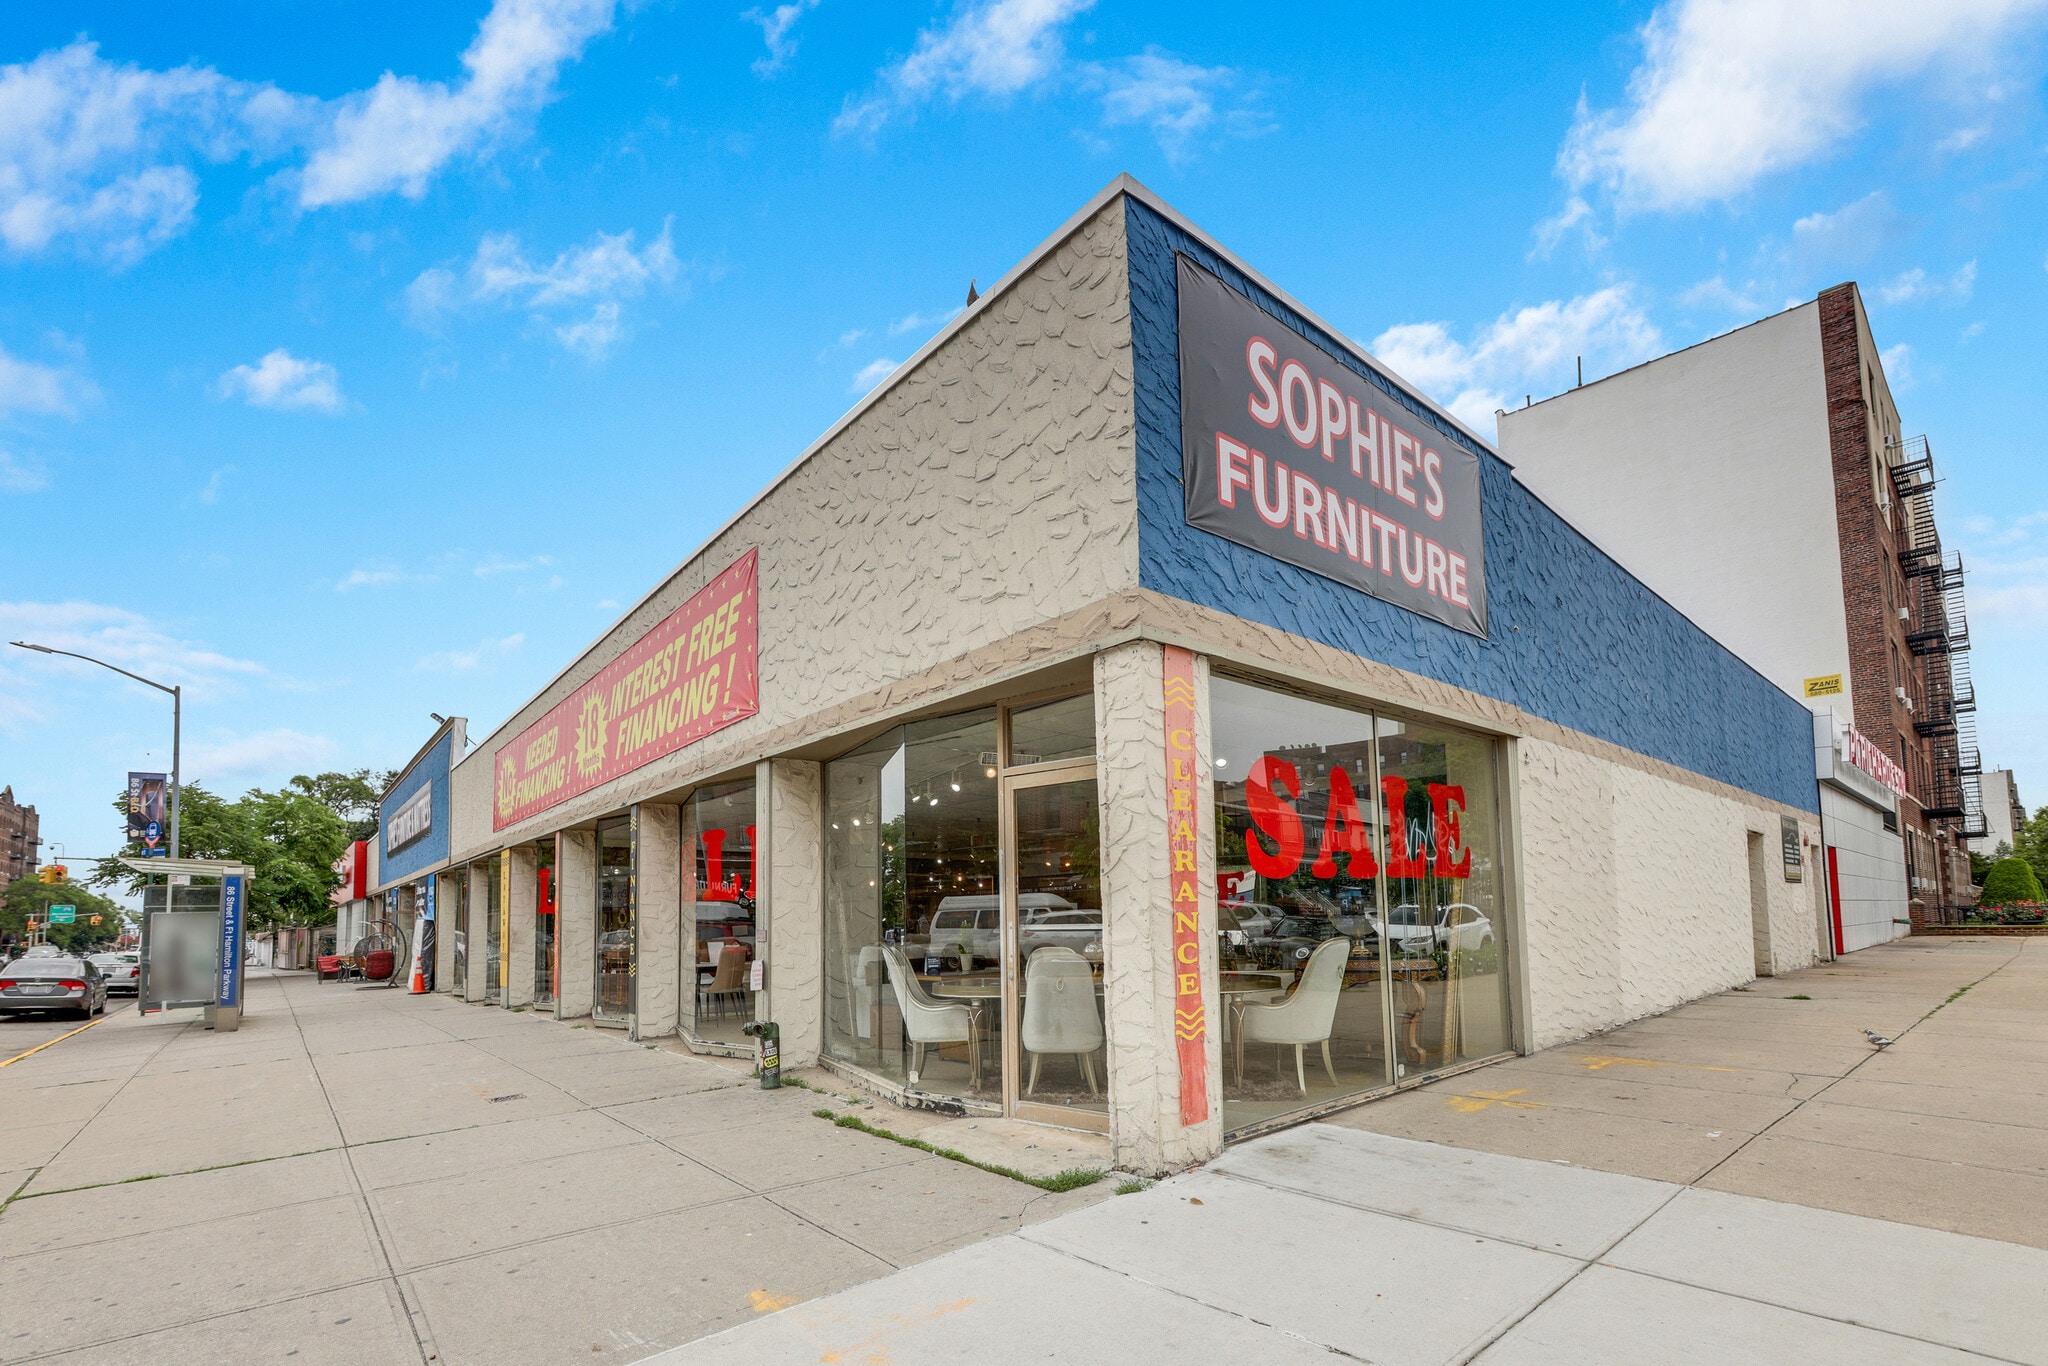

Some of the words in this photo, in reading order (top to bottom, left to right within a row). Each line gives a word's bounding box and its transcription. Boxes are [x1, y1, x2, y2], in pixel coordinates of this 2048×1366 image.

[1246, 336, 1446, 521] SOPHIE'S
[1216, 432, 1470, 610] FURNITURE
[608, 633, 687, 723] INTEREST
[686, 591, 743, 674] FREE
[1809, 678, 1840, 691] ZANIS
[583, 702, 599, 751] 18
[615, 663, 721, 761] FINANCING
[524, 725, 559, 774] NEEDED
[583, 753, 600, 770] Months
[130, 778, 140, 787] 86
[130, 788, 140, 796] St
[515, 755, 567, 810] FINANCING
[1245, 754, 1471, 881] SALE
[1170, 729, 1200, 997] CLEARANCE
[225, 897, 235, 918] Street
[226, 886, 236, 896] 86
[629, 841, 637, 956] FINANCE
[223, 936, 233, 968] Hamilton
[220, 969, 232, 1000] Parkway
